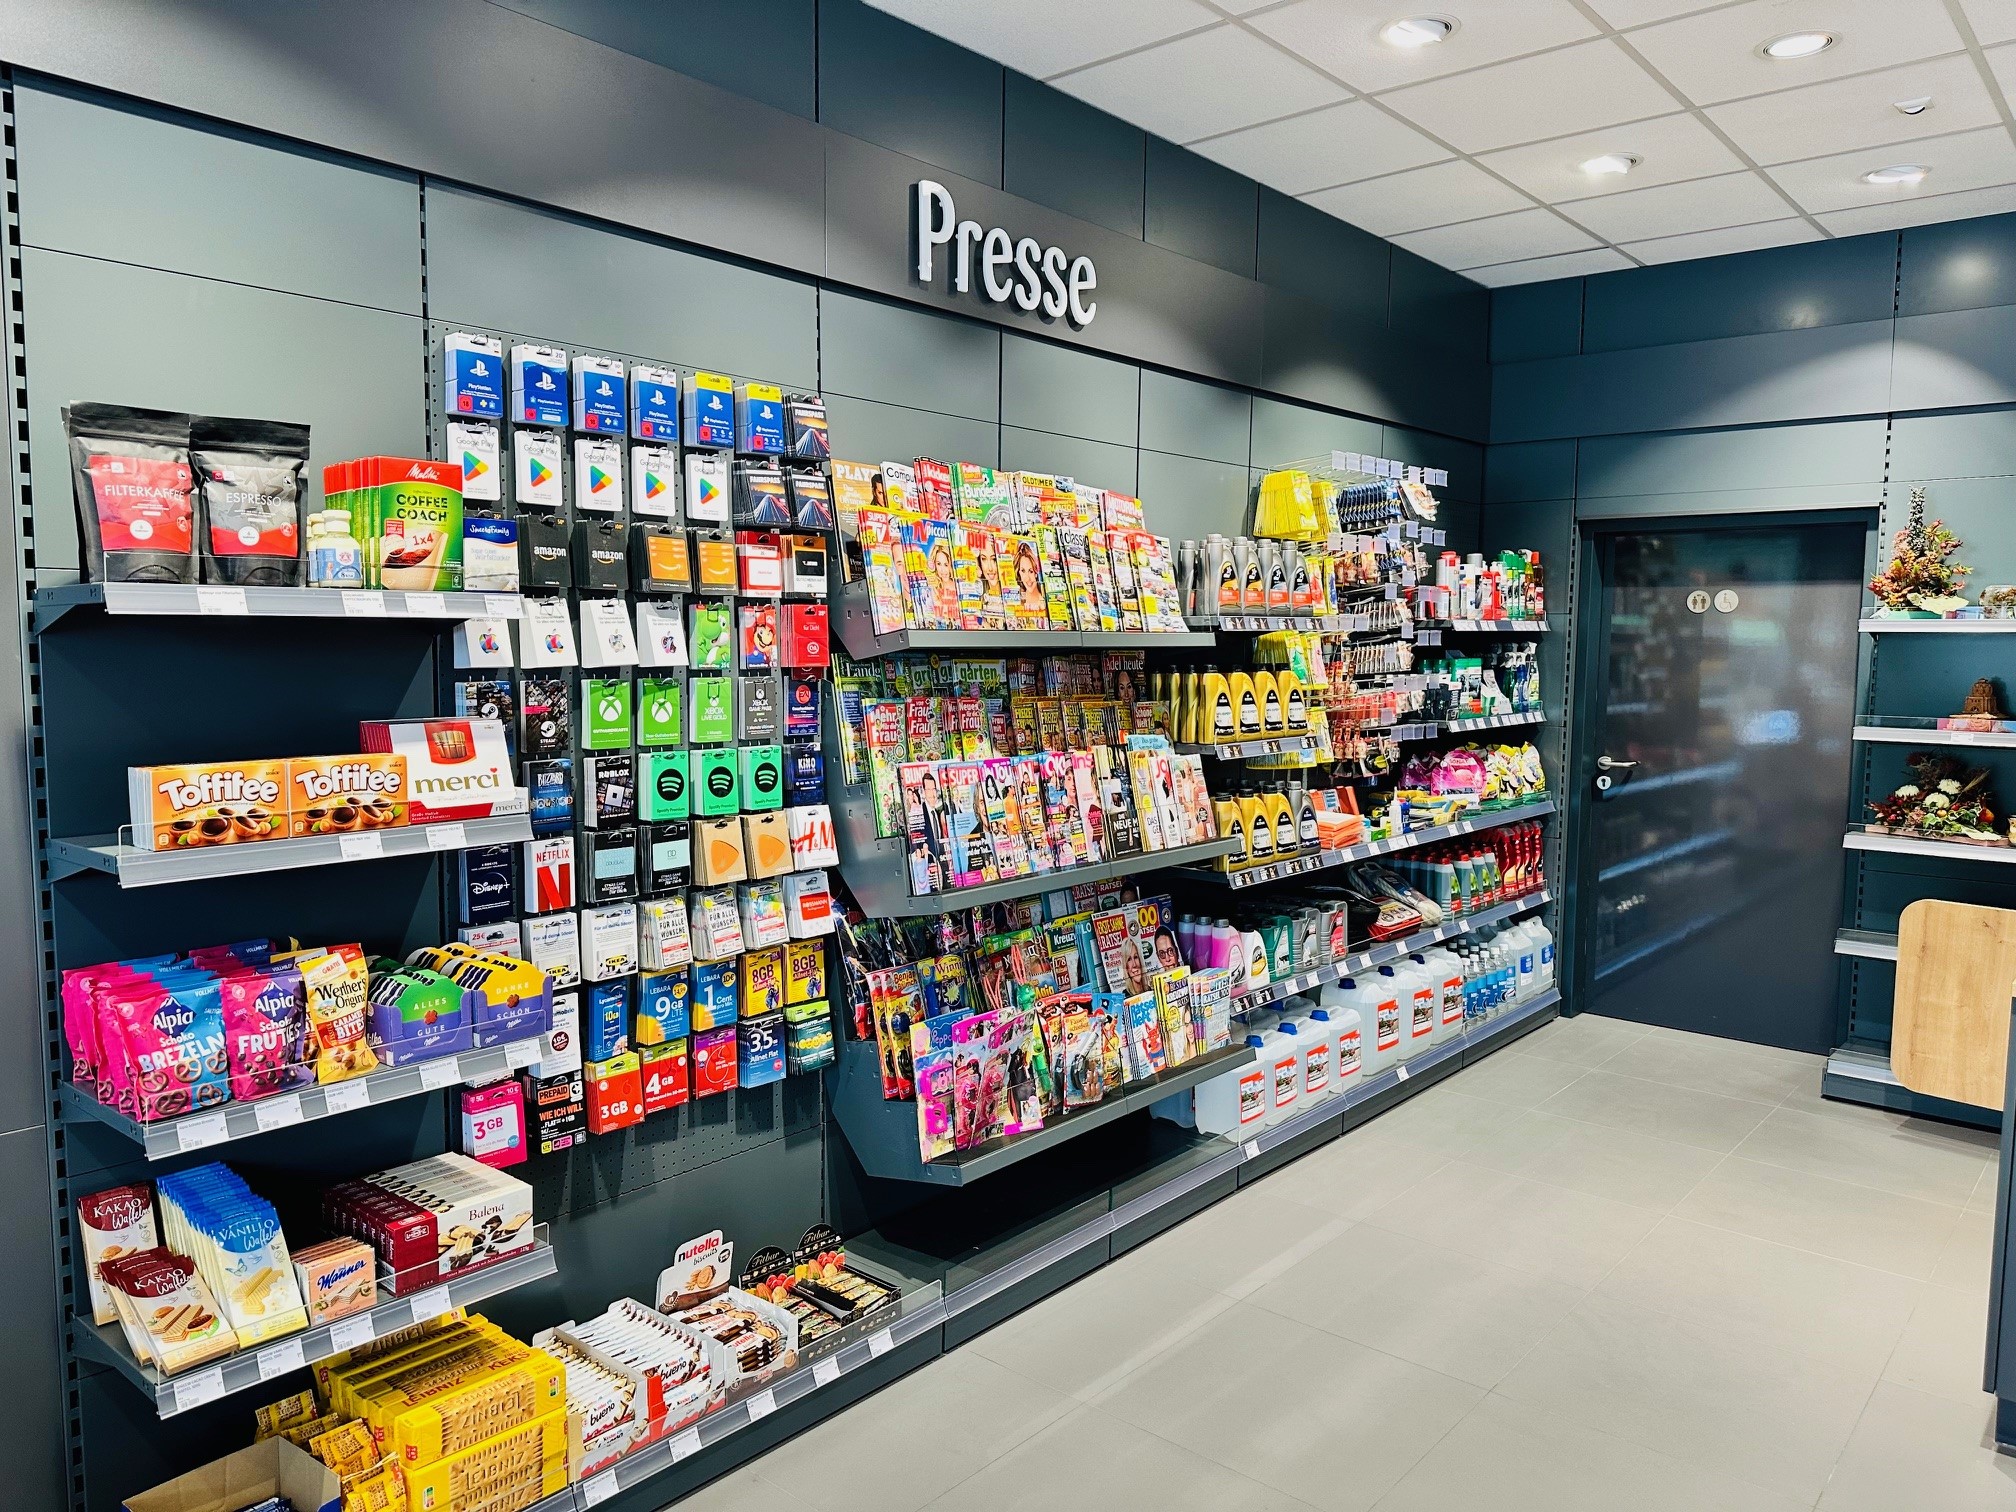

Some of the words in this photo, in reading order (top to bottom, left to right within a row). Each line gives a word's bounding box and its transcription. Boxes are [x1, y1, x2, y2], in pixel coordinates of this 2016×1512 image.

[918, 179, 1097, 326] Presse
[456, 436, 479, 448] Google
[481, 440, 494, 449] Play
[524, 443, 544, 454] Google
[545, 448, 558, 457] Play
[405, 463, 440, 481] Melitta
[886, 467, 915, 482] Compu
[1022, 476, 1053, 487] OLDTIMER
[105, 484, 185, 502] FILTERKAFFEE
[226, 492, 282, 507] ESPRESSO
[396, 494, 448, 509] COFFEE
[397, 508, 448, 522] COACH
[867, 512, 886, 521] SUPER
[412, 532, 434, 546] 1x4
[865, 521, 888, 543] TV
[912, 520, 930, 543] TV
[928, 522, 947, 538] piccol
[967, 532, 987, 550] pur
[534, 546, 566, 557] amazon
[592, 550, 624, 561] amazon
[1122, 655, 1144, 670] heute
[909, 705, 929, 718] Frau
[959, 702, 979, 711] Neues
[870, 708, 897, 723] Mehr
[962, 715, 981, 731] Frau
[910, 721, 930, 735] Frau
[871, 729, 897, 744] Frau
[598, 768, 630, 779] ROBLOX
[950, 768, 980, 786] SUPER
[1155, 760, 1167, 779] JO
[296, 763, 401, 801] Toffifee
[414, 770, 500, 794] merci
[158, 770, 280, 812] Toffifee
[495, 802, 524, 812] merci
[1113, 819, 1132, 830] NEUE
[536, 849, 570, 863] NETFLIX
[470, 881, 511, 895] Disney+
[709, 912, 722, 921] FÜR
[723, 911, 735, 919] ALLE
[711, 917, 737, 930] WÜNSCHE
[659, 920, 671, 931] FÜR
[672, 919, 684, 928] ALLE
[661, 927, 686, 939] WÜNSCHE
[322, 961, 341, 974] GRATIS
[607, 957, 625, 965] IKEA
[793, 954, 817, 972] 8GB
[549, 967, 567, 975] IKEA
[701, 973, 721, 983] LEBARA
[723, 974, 734, 983] 10€
[752, 964, 774, 983] 8GB
[1057, 973, 1070, 985] 116
[496, 982, 529, 995] DANKE
[650, 985, 671, 995] LEBARA
[255, 992, 295, 1018] Alpia
[413, 997, 447, 1011] ALLES
[704, 984, 717, 1011] 1
[716, 994, 733, 1004] Cent
[496, 1007, 531, 1021] SCHÖN
[655, 996, 671, 1021] 9
[671, 1000, 684, 1008] GB
[671, 1008, 684, 1018] LTE
[152, 1012, 194, 1034] Alpia
[335, 1020, 365, 1040] BITES
[417, 1024, 446, 1037] GUTE
[506, 1018, 523, 1029] Milka
[159, 1031, 195, 1048] Schoko
[366, 1031, 383, 1048] ilka
[424, 1035, 440, 1046] Milka
[484, 1033, 499, 1044] Milka
[750, 1029, 773, 1053] 3,5
[138, 1031, 226, 1074] BREZELN
[398, 1052, 414, 1062] Milka
[750, 1052, 768, 1063] Allnet
[768, 1050, 779, 1059] Flat
[645, 1072, 662, 1095] 4
[661, 1076, 674, 1086] GB
[539, 1086, 568, 1099] PREPAID
[539, 1110, 554, 1121] WIE
[554, 1106, 566, 1119] ICH
[566, 1103, 584, 1115] WILL
[600, 1105, 610, 1119] 3
[610, 1101, 629, 1117] GB
[473, 1121, 486, 1140] 3
[486, 1117, 503, 1130] GB
[93, 1198, 142, 1218] KAKAO
[469, 1203, 505, 1221] Balena
[112, 1206, 151, 1230] Waffeln
[218, 1219, 275, 1241] VANILLO
[804, 1229, 831, 1244] Fitbar
[243, 1226, 282, 1251] Waffeln
[678, 1236, 720, 1263] nutella
[693, 1247, 718, 1266] biscuits
[752, 1251, 780, 1268] Fitbar
[134, 1267, 184, 1291] KAKAO
[317, 1259, 367, 1291] Manner
[156, 1273, 195, 1297] Waffeln
[444, 1325, 485, 1344] KEKS
[728, 1332, 756, 1348] utella
[660, 1361, 687, 1382] bueno
[402, 1377, 466, 1408] LEIBNIZ
[487, 1351, 531, 1371] KEKS
[590, 1402, 616, 1427] bueno
[467, 1450, 526, 1491] LEIBNIZ
